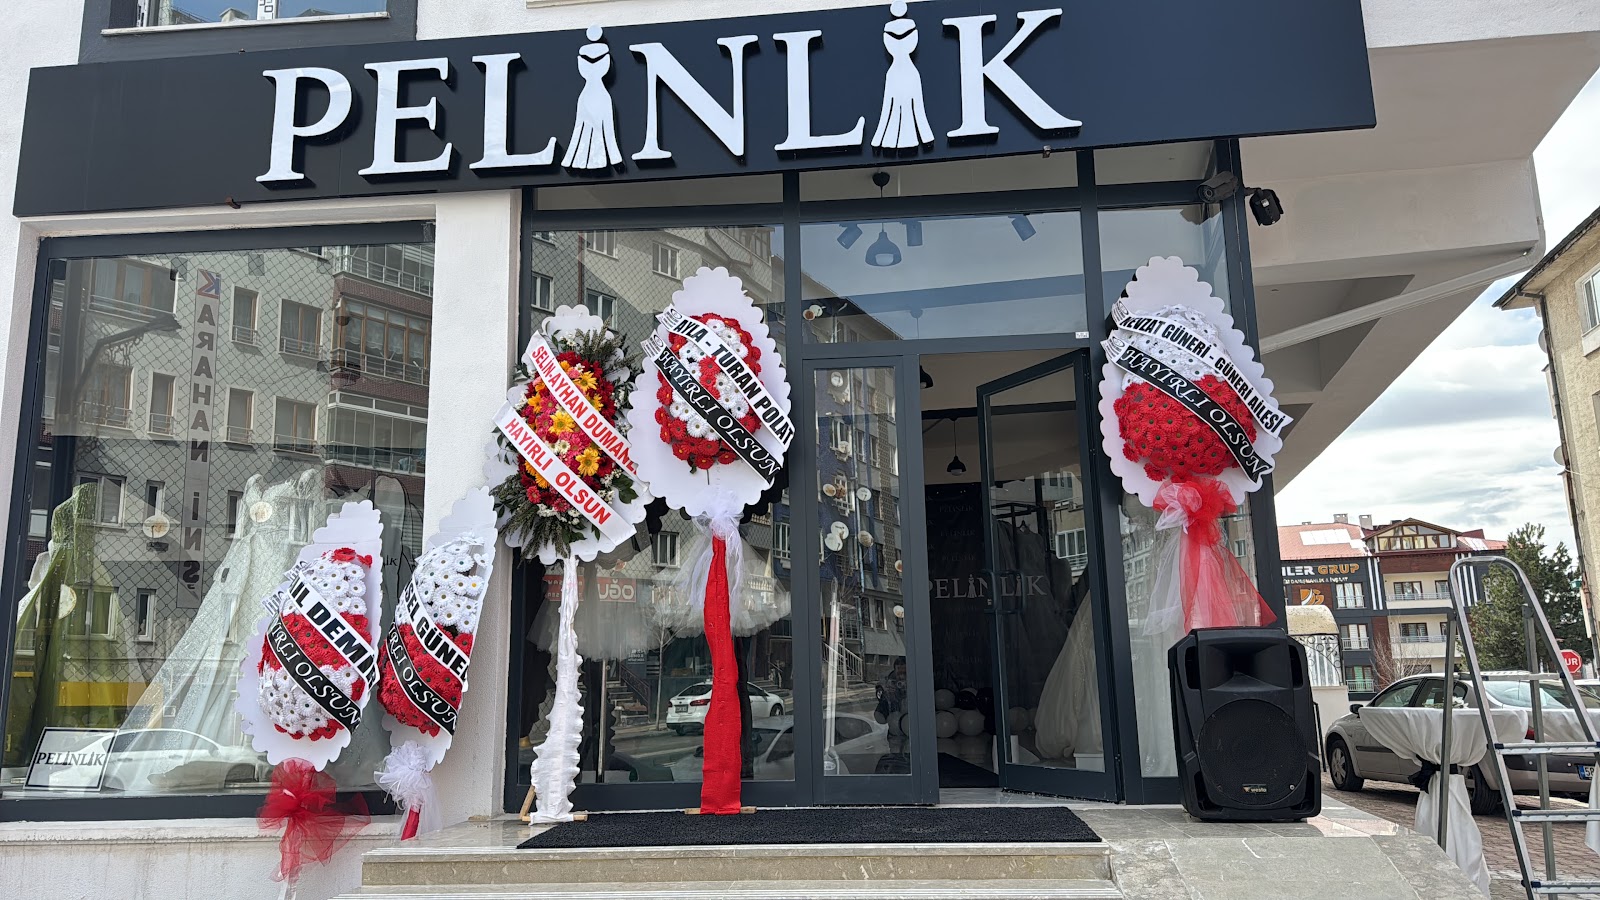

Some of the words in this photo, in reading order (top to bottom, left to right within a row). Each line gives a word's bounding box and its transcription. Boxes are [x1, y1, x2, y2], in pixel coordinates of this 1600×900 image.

[531, 345, 588, 419] SELİN-AYHAN
[583, 413, 638, 475] DUMANL
[659, 350, 720, 415] HAYIRLI
[717, 414, 781, 476] OLSUN
[674, 320, 704, 342] AYLA
[712, 344, 761, 400] TURAN
[754, 396, 794, 445] POLAT
[1125, 349, 1210, 408] HAYIRLI
[1209, 407, 1271, 474] OLSUN
[1162, 323, 1212, 358] GÜNERİ
[1215, 357, 1254, 400] GÜNERİ
[1248, 395, 1286, 433] AİLESİ
[504, 418, 553, 471] HAYIRLI
[555, 471, 612, 525] OLSUN
[1317, 563, 1360, 575] GRUP
[1564, 657, 1578, 666] UR
